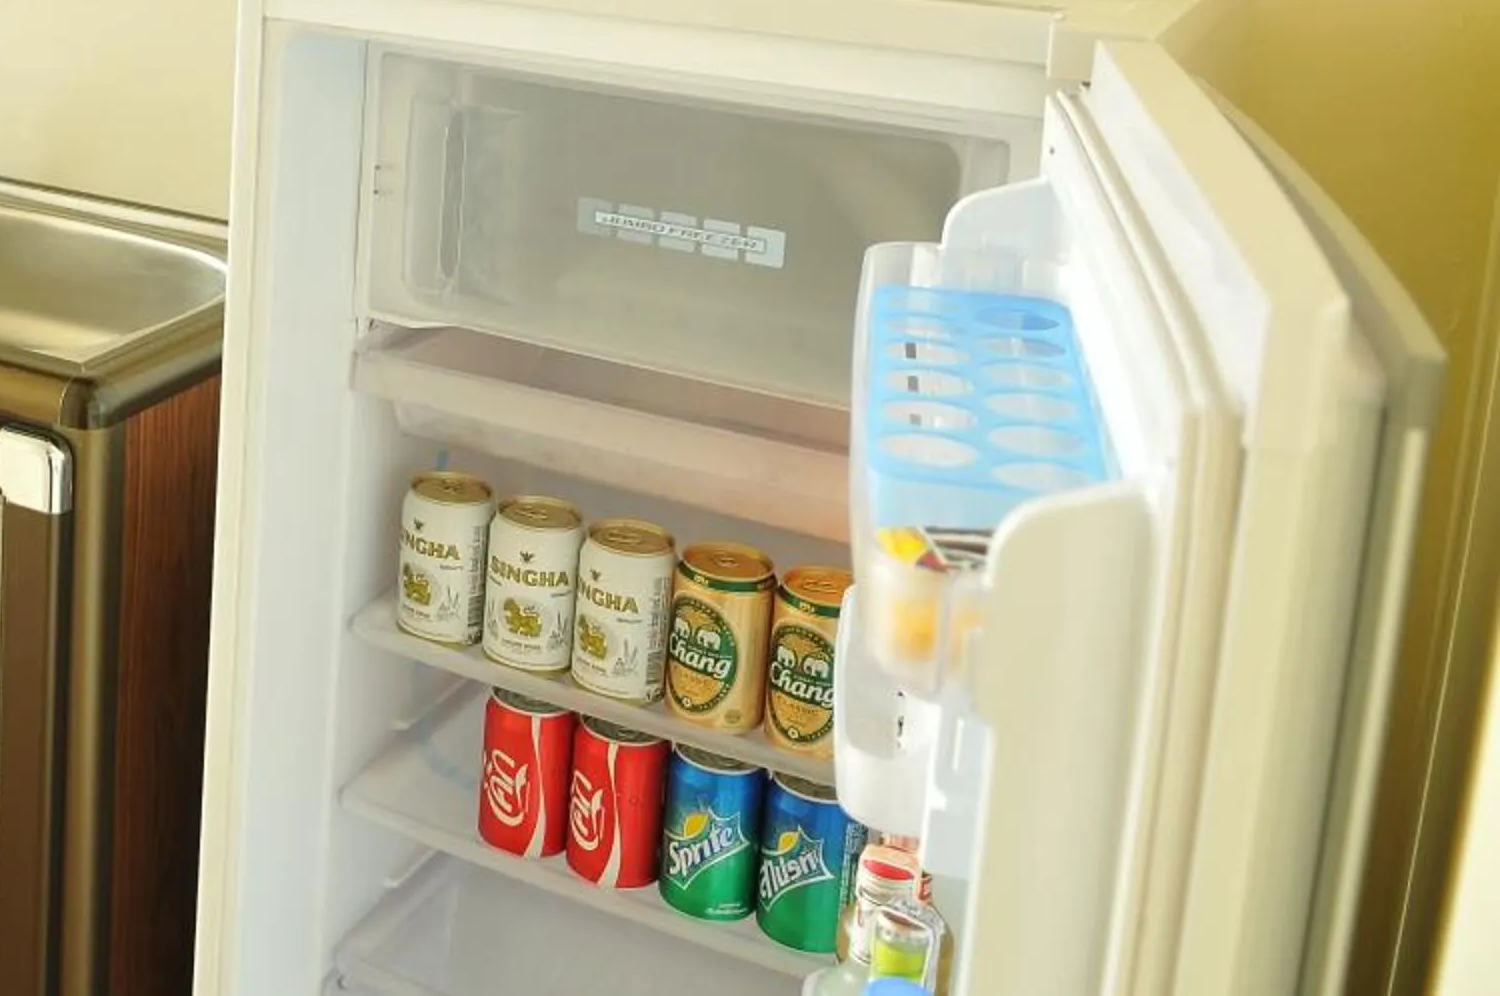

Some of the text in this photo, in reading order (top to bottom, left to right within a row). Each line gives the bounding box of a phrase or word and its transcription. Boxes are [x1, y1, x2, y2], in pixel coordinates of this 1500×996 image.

[401, 528, 461, 561] NGHA
[489, 555, 569, 587] SINGHA
[579, 576, 639, 614] NGHA
[669, 632, 733, 679] Chang
[770, 661, 835, 707] Chang
[668, 822, 733, 878] Sprite
